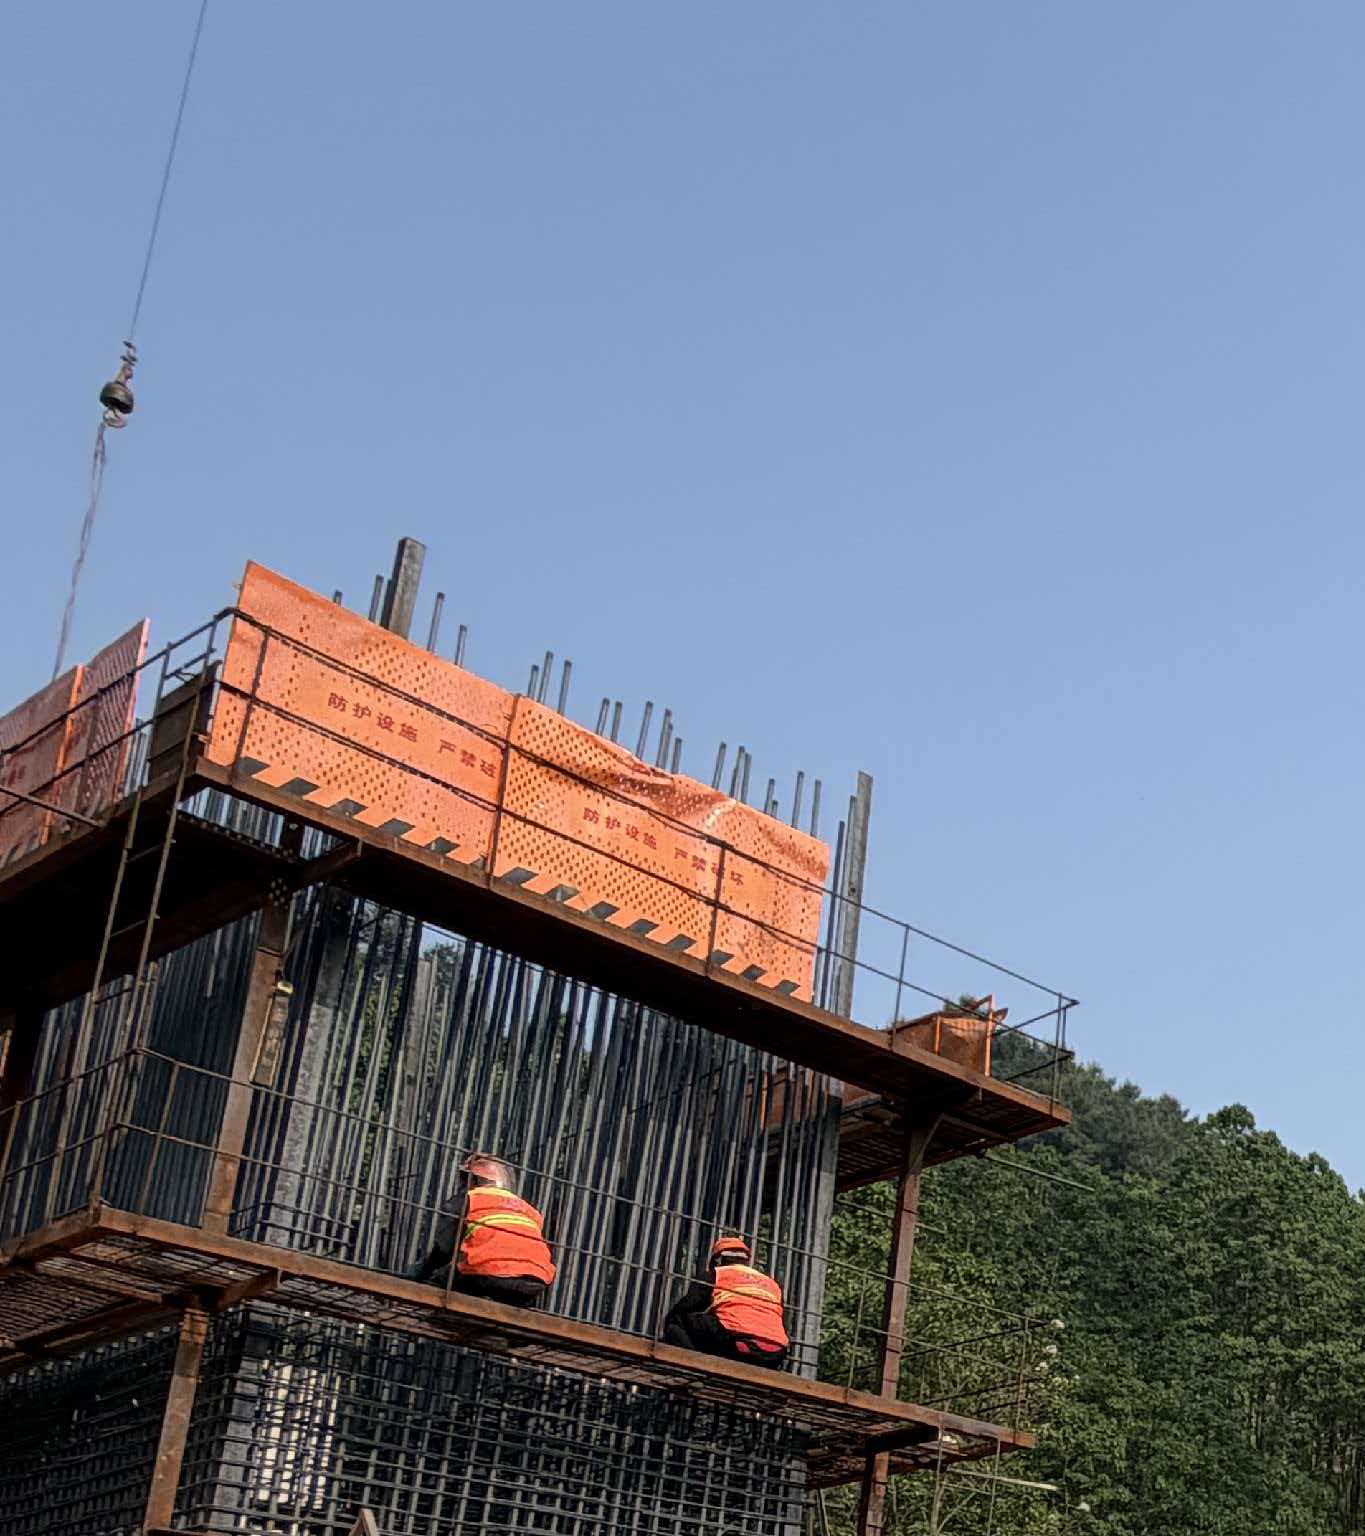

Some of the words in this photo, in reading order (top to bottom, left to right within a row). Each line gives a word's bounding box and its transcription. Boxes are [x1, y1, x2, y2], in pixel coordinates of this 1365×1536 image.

[327, 692, 419, 743] 防护设施
[583, 807, 657, 850] 防护设施
